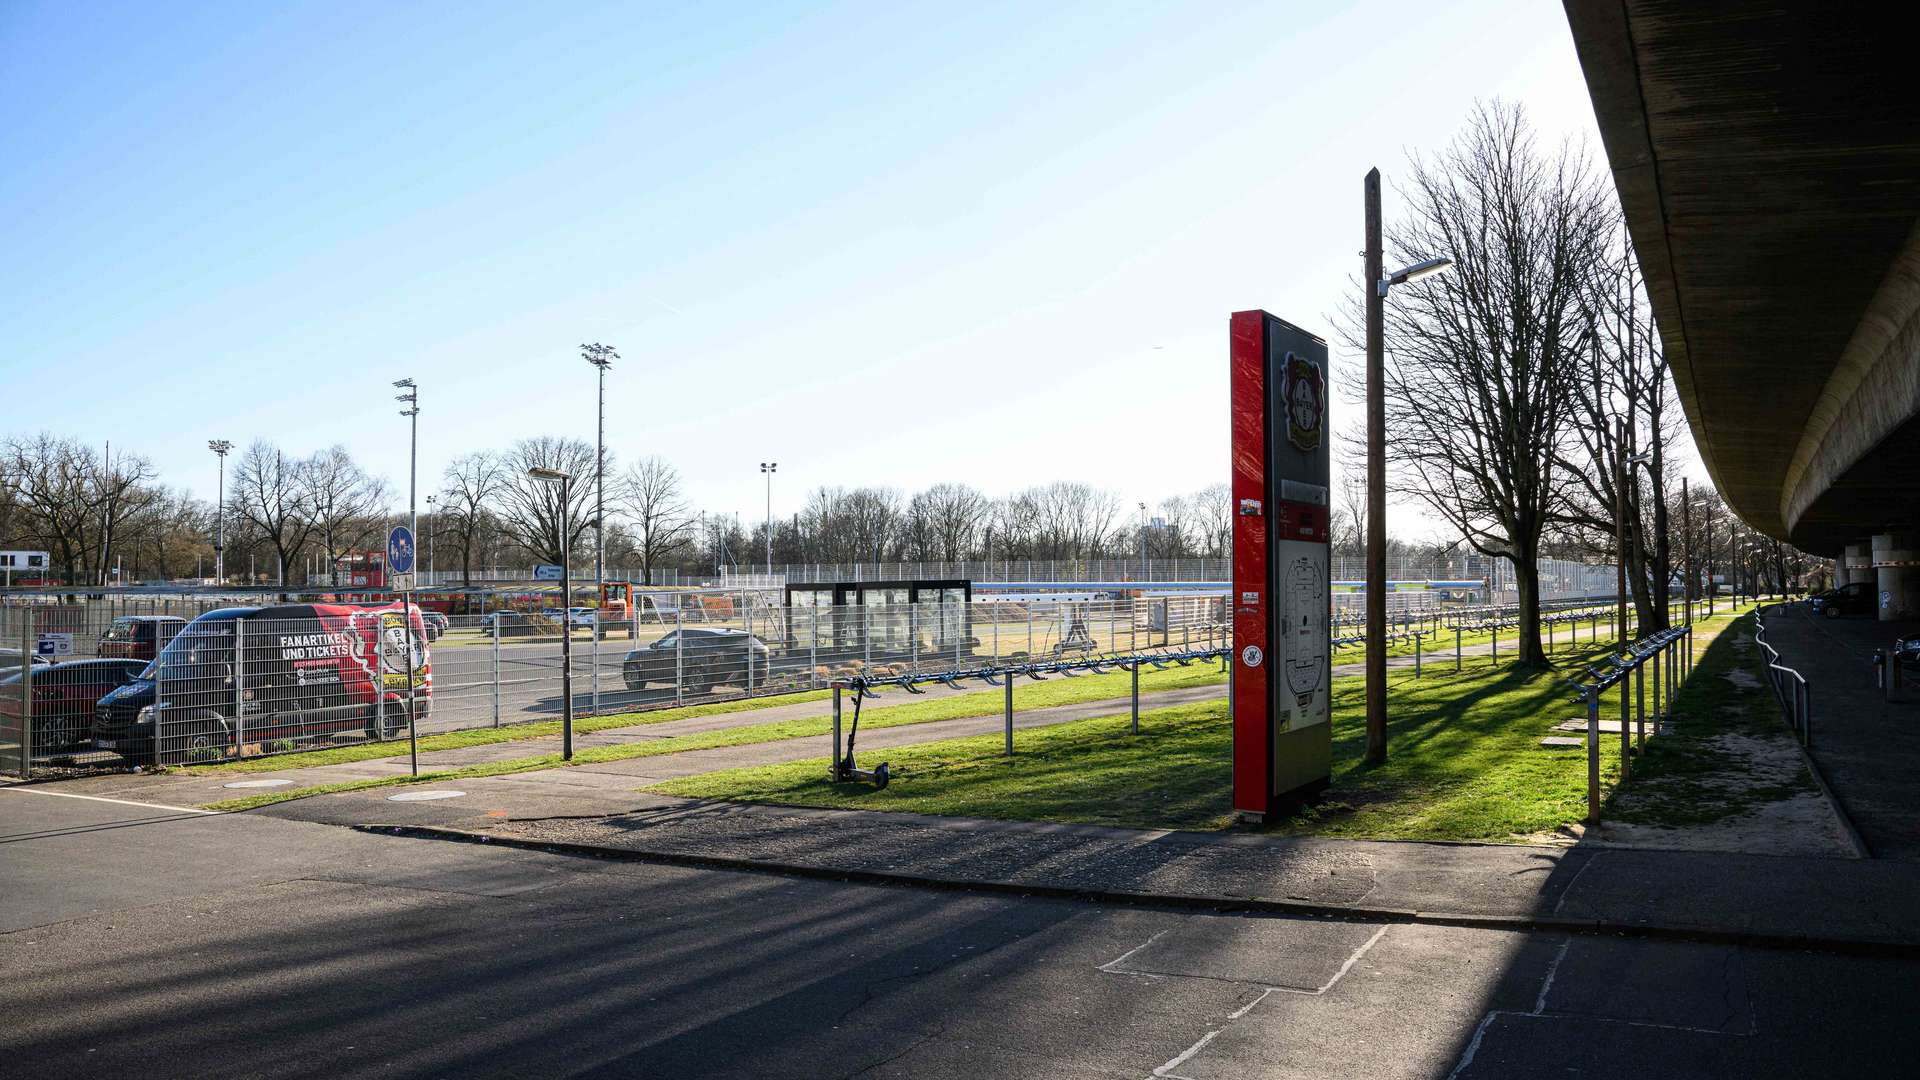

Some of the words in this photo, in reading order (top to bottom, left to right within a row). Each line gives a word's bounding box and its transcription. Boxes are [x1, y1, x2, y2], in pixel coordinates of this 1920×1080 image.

[280, 633, 348, 647] FANARTIKEL
[282, 647, 305, 660] UND
[306, 645, 348, 657] TICKETS
